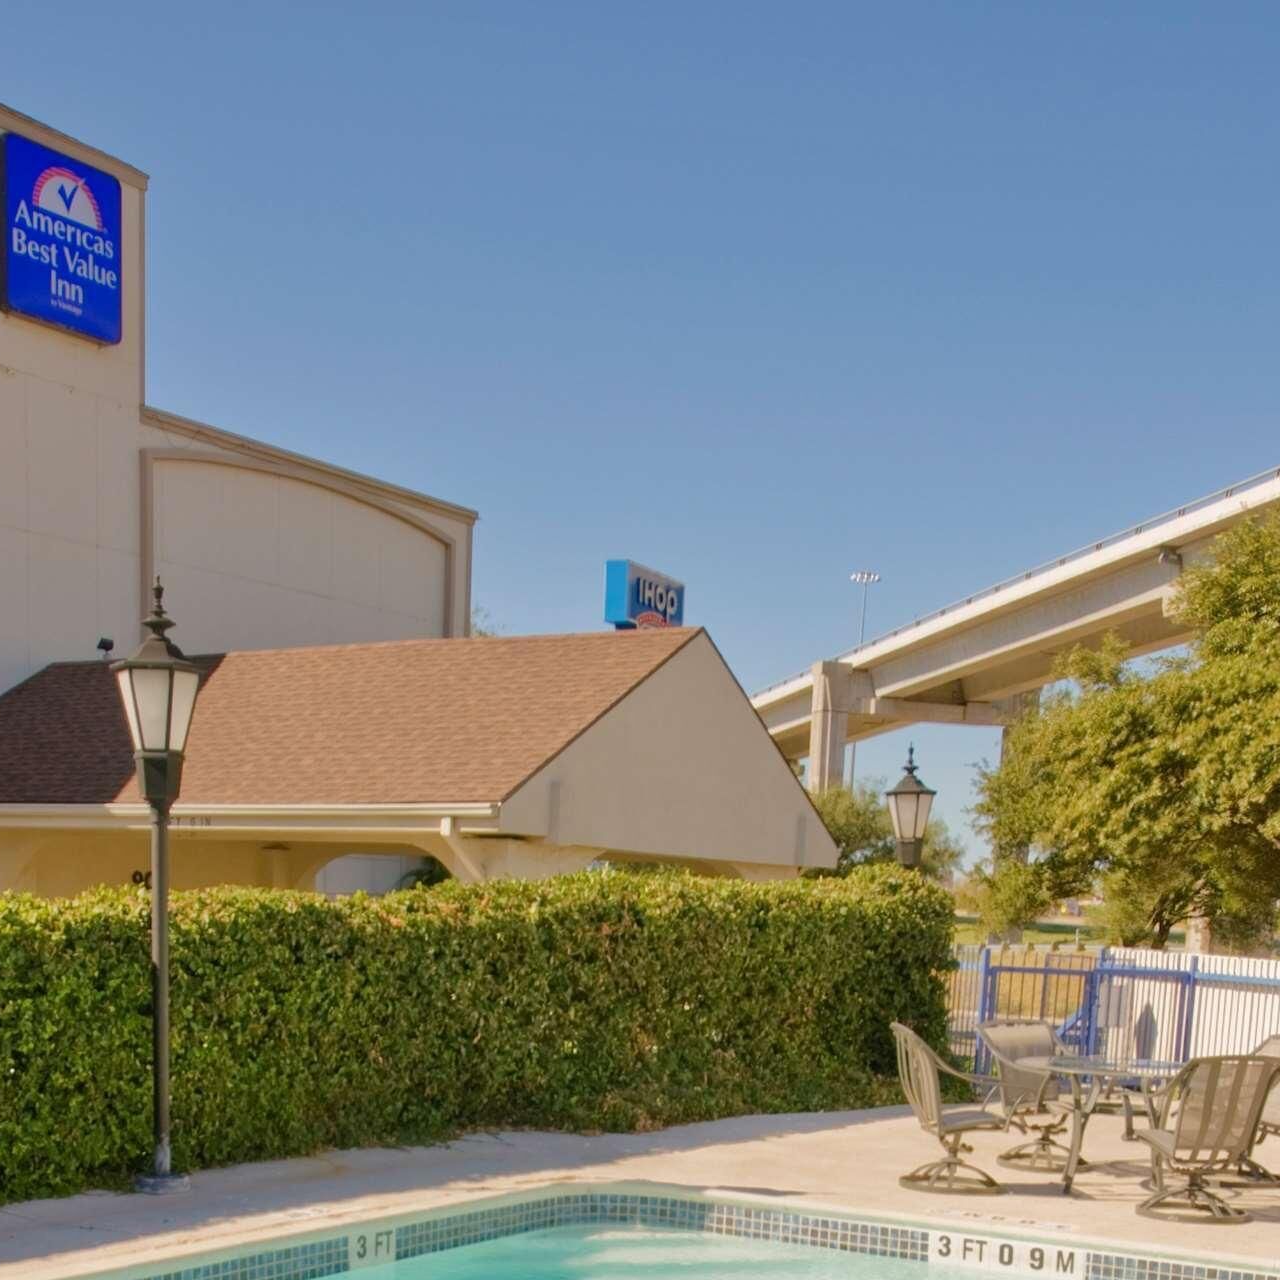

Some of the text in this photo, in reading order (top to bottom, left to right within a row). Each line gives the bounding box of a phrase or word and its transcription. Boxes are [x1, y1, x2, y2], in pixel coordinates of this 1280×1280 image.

[15, 199, 114, 259] Americas
[12, 227, 118, 289] Best Value
[51, 270, 83, 305] Inn
[357, 1230, 394, 1259] 3 FT
[938, 1235, 952, 1257] 3
[962, 1238, 988, 1263] FT
